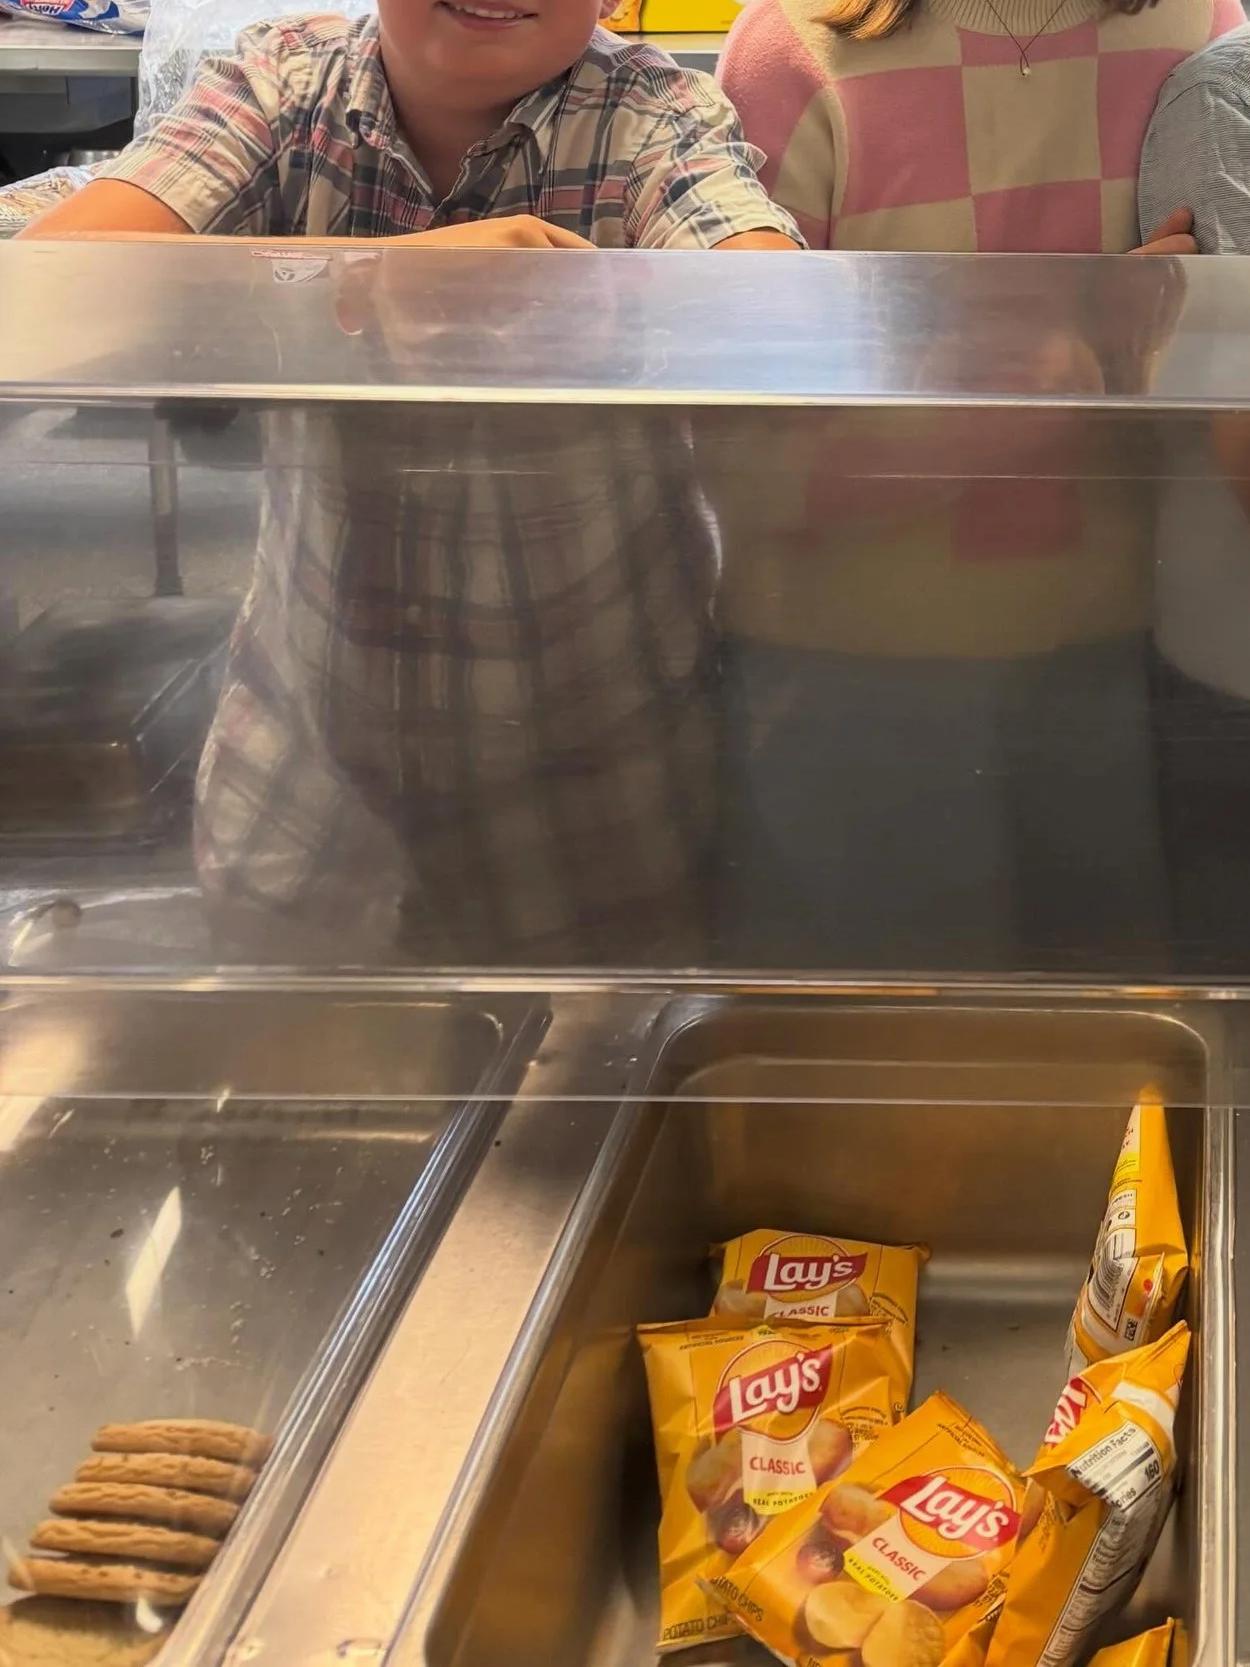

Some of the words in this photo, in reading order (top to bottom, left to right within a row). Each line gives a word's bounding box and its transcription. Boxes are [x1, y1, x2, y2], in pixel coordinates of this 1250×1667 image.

[763, 1253, 855, 1291] Lay's
[729, 1352, 820, 1422] Lay's
[749, 1456, 806, 1476] CLASSIC
[1071, 1443, 1112, 1479] Nutrition
[1111, 1427, 1137, 1450] Facts
[1143, 1460, 1160, 1482] 160
[899, 1476, 1009, 1540] Lay's
[871, 1537, 930, 1581] CLASSIC
[738, 1592, 765, 1622] CHIPS
[663, 1618, 705, 1641] POTATO
